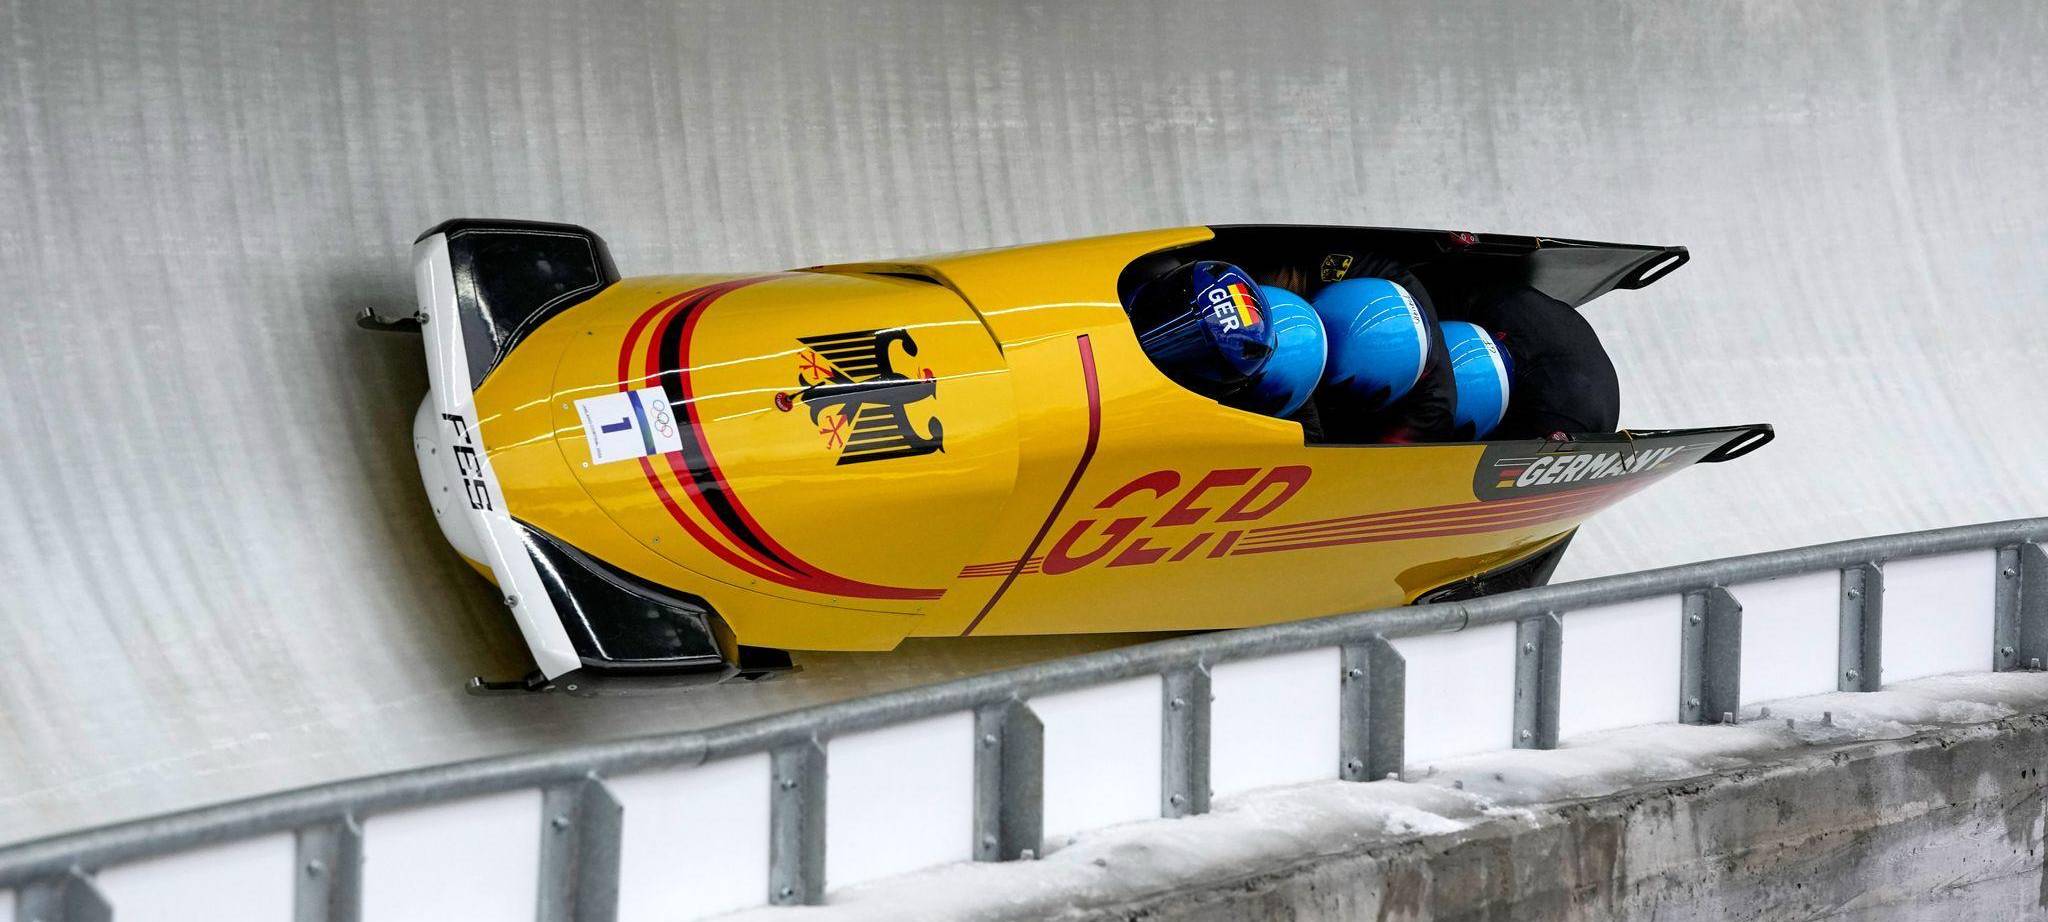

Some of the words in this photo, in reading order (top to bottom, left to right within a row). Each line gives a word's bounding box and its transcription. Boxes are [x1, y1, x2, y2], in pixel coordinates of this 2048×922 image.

[1208, 287, 1240, 334] GER
[600, 416, 633, 434] 1
[441, 413, 493, 512] FES
[1516, 445, 1687, 488] GERMANY
[1041, 464, 1313, 576] GER
